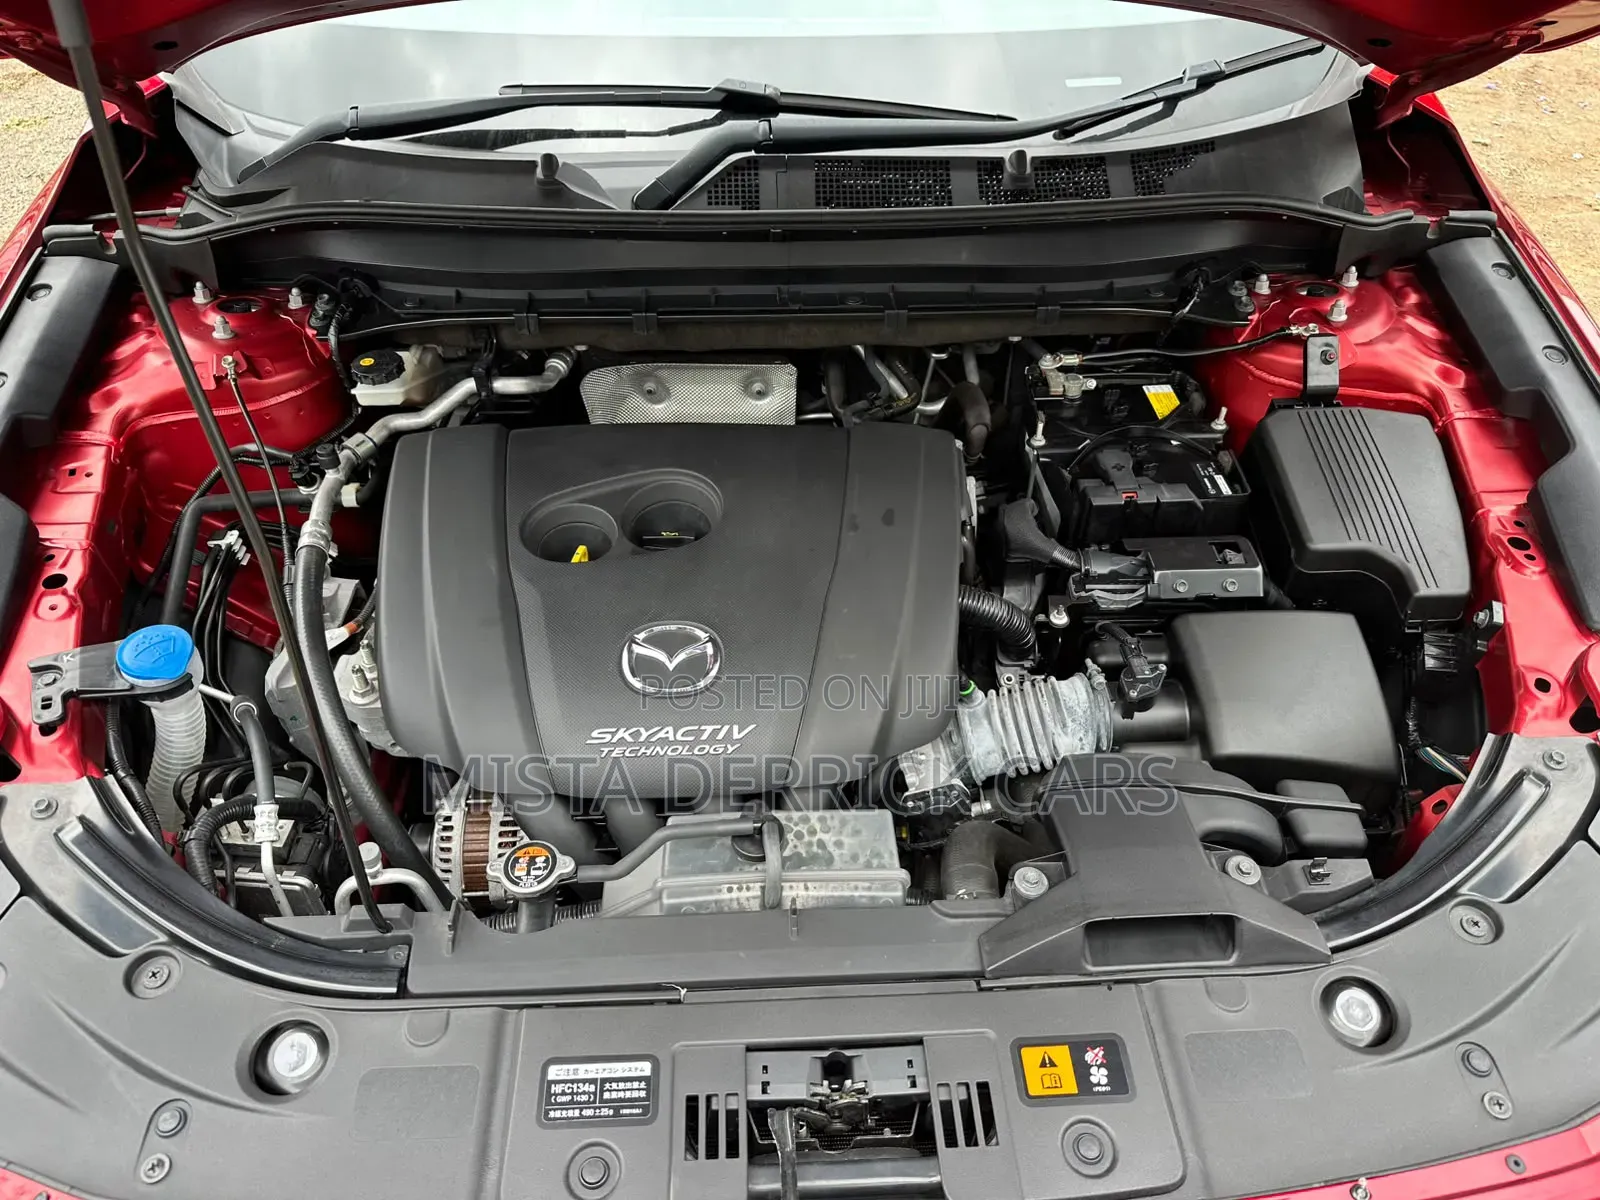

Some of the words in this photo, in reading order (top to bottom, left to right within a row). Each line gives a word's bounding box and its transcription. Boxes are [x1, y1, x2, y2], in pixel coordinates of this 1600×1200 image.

[586, 724, 757, 744] SKYACTIV
[599, 743, 742, 758] TECHNOLOGY
[551, 1083, 595, 1094] HFC134a
